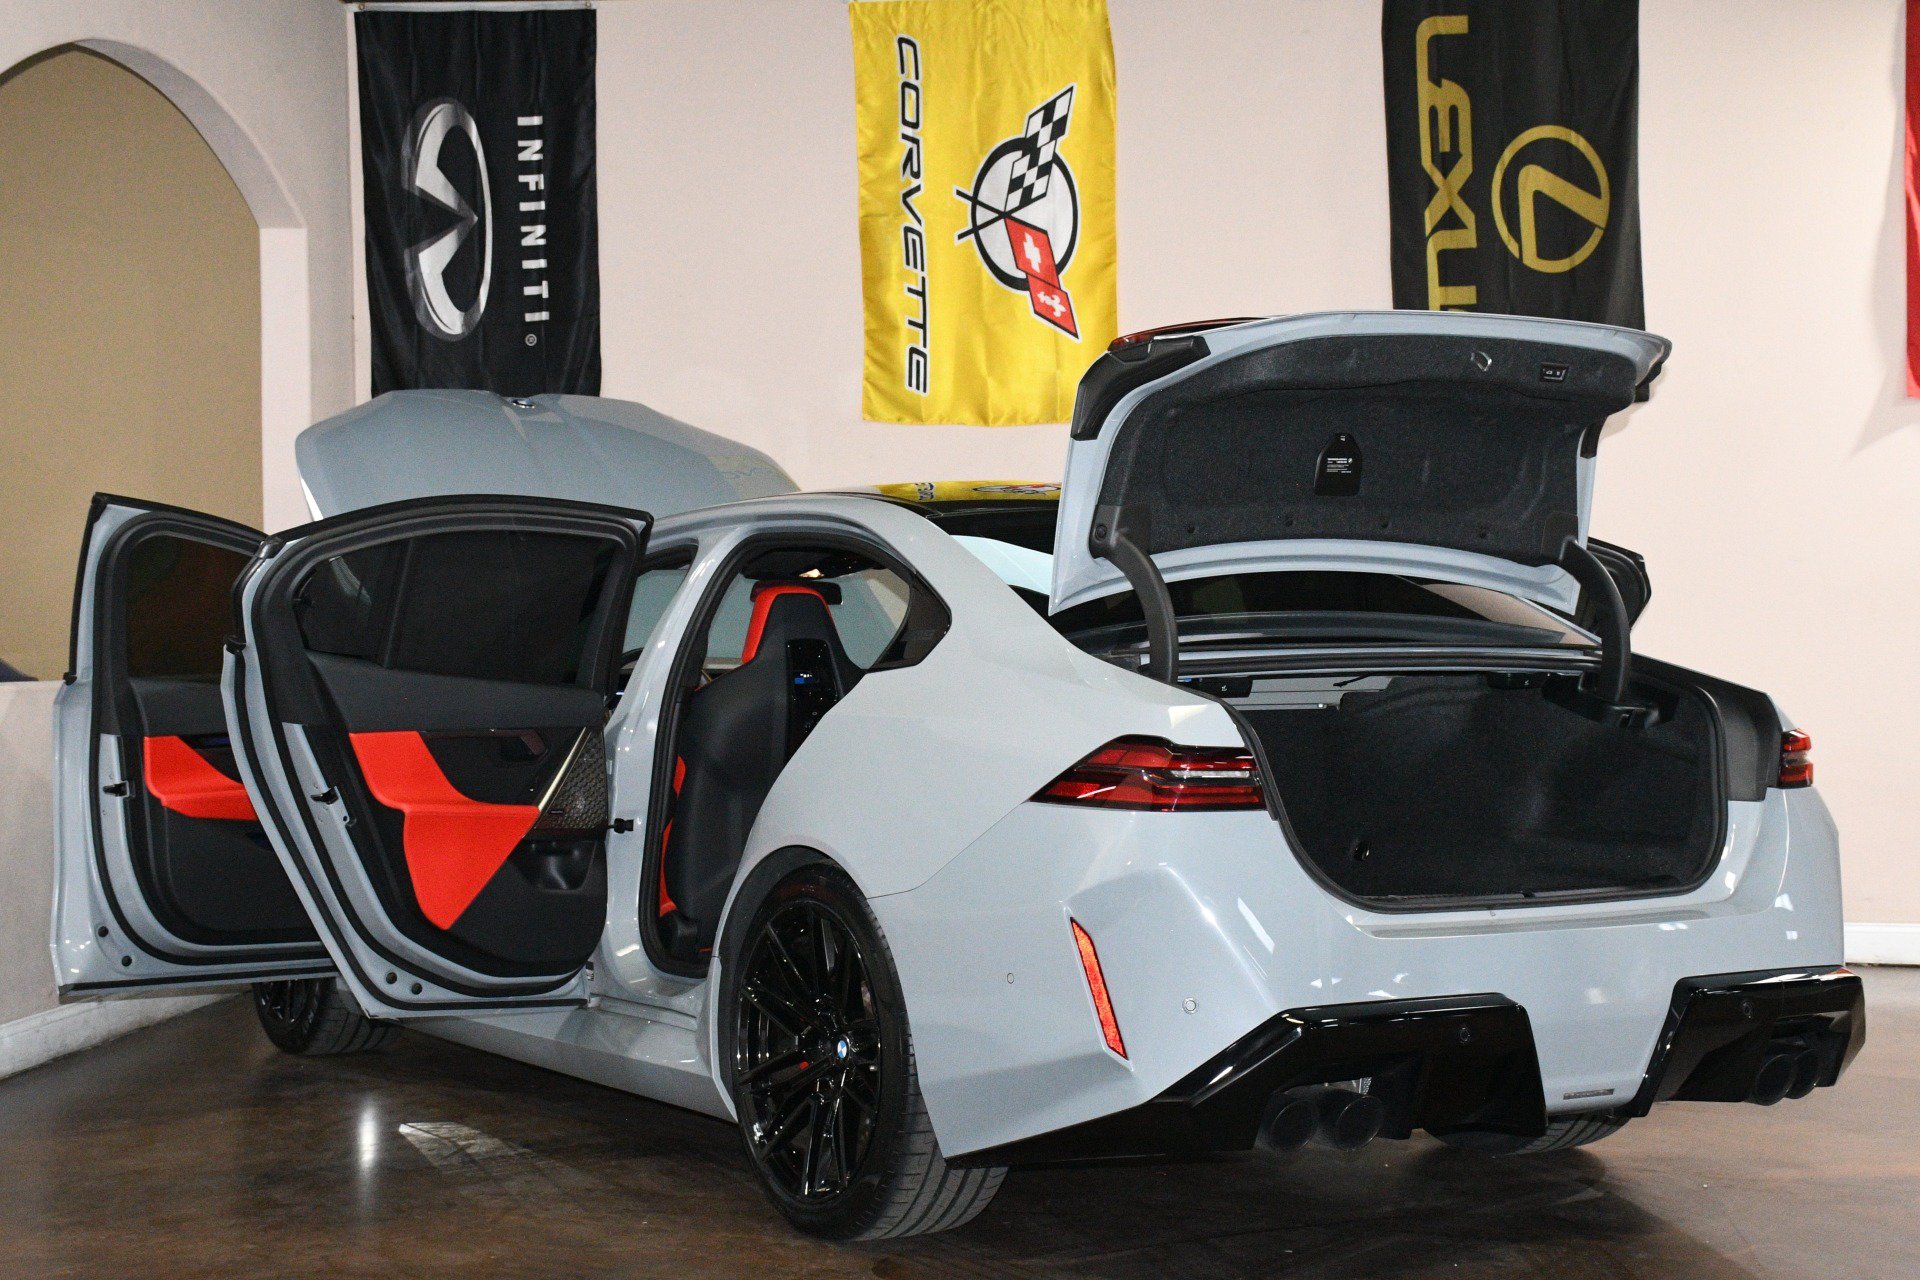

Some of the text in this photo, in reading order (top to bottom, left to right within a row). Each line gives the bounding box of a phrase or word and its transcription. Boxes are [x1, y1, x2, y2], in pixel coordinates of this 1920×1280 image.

[517, 115, 550, 322] INFINITI
[896, 35, 928, 395] CORVETTE
[1416, 15, 1477, 311] LEXU
